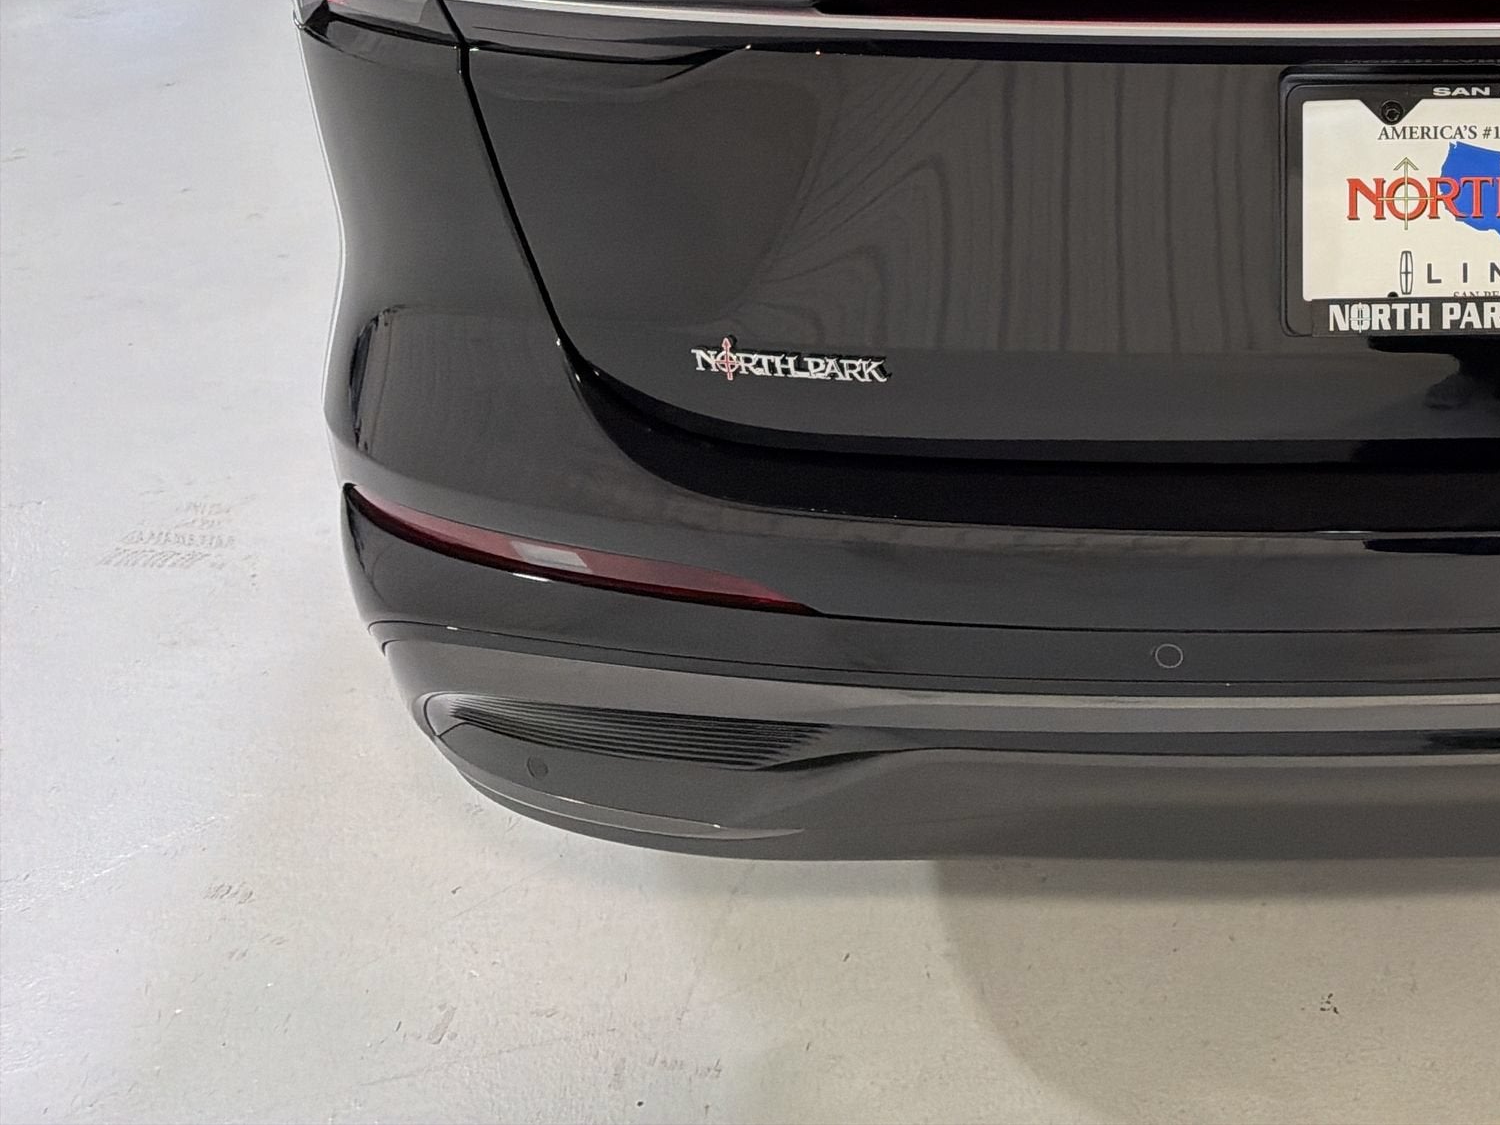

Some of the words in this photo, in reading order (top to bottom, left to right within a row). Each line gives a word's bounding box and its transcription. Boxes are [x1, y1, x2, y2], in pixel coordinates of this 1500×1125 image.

[1432, 86, 1491, 97] SAN
[1377, 125, 1478, 141] AMERICA'S
[1482, 126, 1500, 140] #1
[1328, 302, 1431, 332] NORTH
[690, 348, 798, 378] NORTH
[804, 356, 887, 382] PARK
